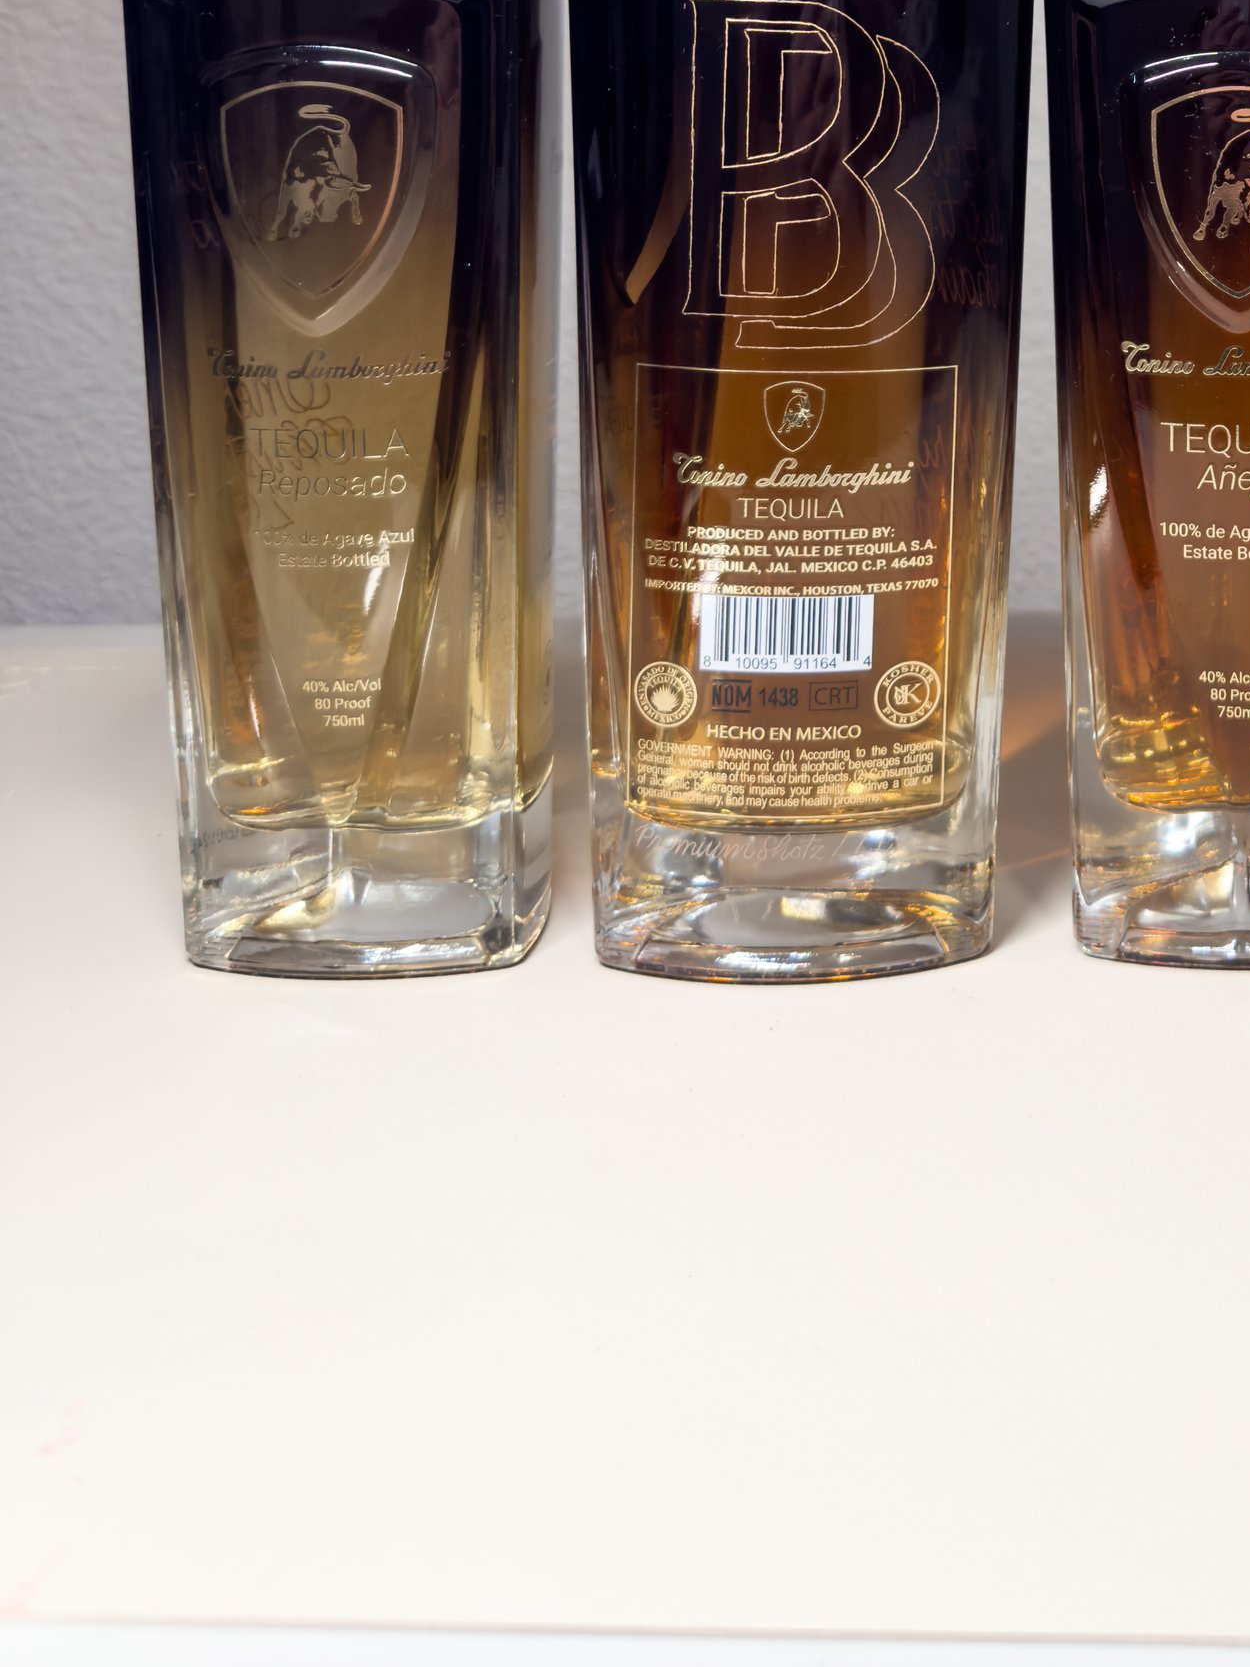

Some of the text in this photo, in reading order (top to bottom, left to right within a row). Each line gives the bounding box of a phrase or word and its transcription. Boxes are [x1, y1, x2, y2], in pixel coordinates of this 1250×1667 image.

[288, 348, 452, 388] Lamborghini
[1120, 340, 1195, 375] Tonino
[250, 428, 410, 460] TEQUILA
[673, 452, 914, 493] Tonino Lamborghini
[259, 467, 407, 502] Reposado
[737, 497, 844, 521] TEQUILA
[300, 530, 319, 545] de
[323, 533, 374, 549] Agave
[378, 528, 415, 543] Azul
[687, 525, 895, 541] PRODUCED AND BOTTLED BY:
[1160, 522, 1201, 537] 100%
[1206, 524, 1226, 538] de
[645, 538, 937, 557] DESTILADORA DEL VALLE DE TEQUILA S.A.
[1183, 544, 1233, 560] Estate
[279, 551, 391, 567] Estate Bottled
[649, 554, 933, 575] DE C.V. TEQUILA, JAL. MEXICO C.P. 46403
[645, 578, 698, 593] IMPORTED
[722, 584, 771, 596] MEXCOR
[773, 585, 800, 598] INC.,
[803, 584, 864, 597] HOUSTON,
[868, 581, 902, 593] TEXAS
[905, 577, 938, 590] 77070
[703, 655, 872, 670] 8 10095 91164 4
[302, 677, 381, 692] 40% Alc/Vol
[882, 664, 936, 686] KOSHER
[1199, 670, 1226, 683] 40%
[314, 695, 371, 709] 80 Proof
[711, 684, 851, 707] NOM 1438 CRT
[1210, 688, 1227, 700] 80
[323, 714, 365, 726] 750ml
[882, 700, 934, 724] PAREVE
[707, 724, 863, 741] HECHO EN MEXICO
[637, 738, 934, 763] GOVERNMENT WARNING: (1) According to the Surgeon
[634, 823, 756, 860] Prmium
